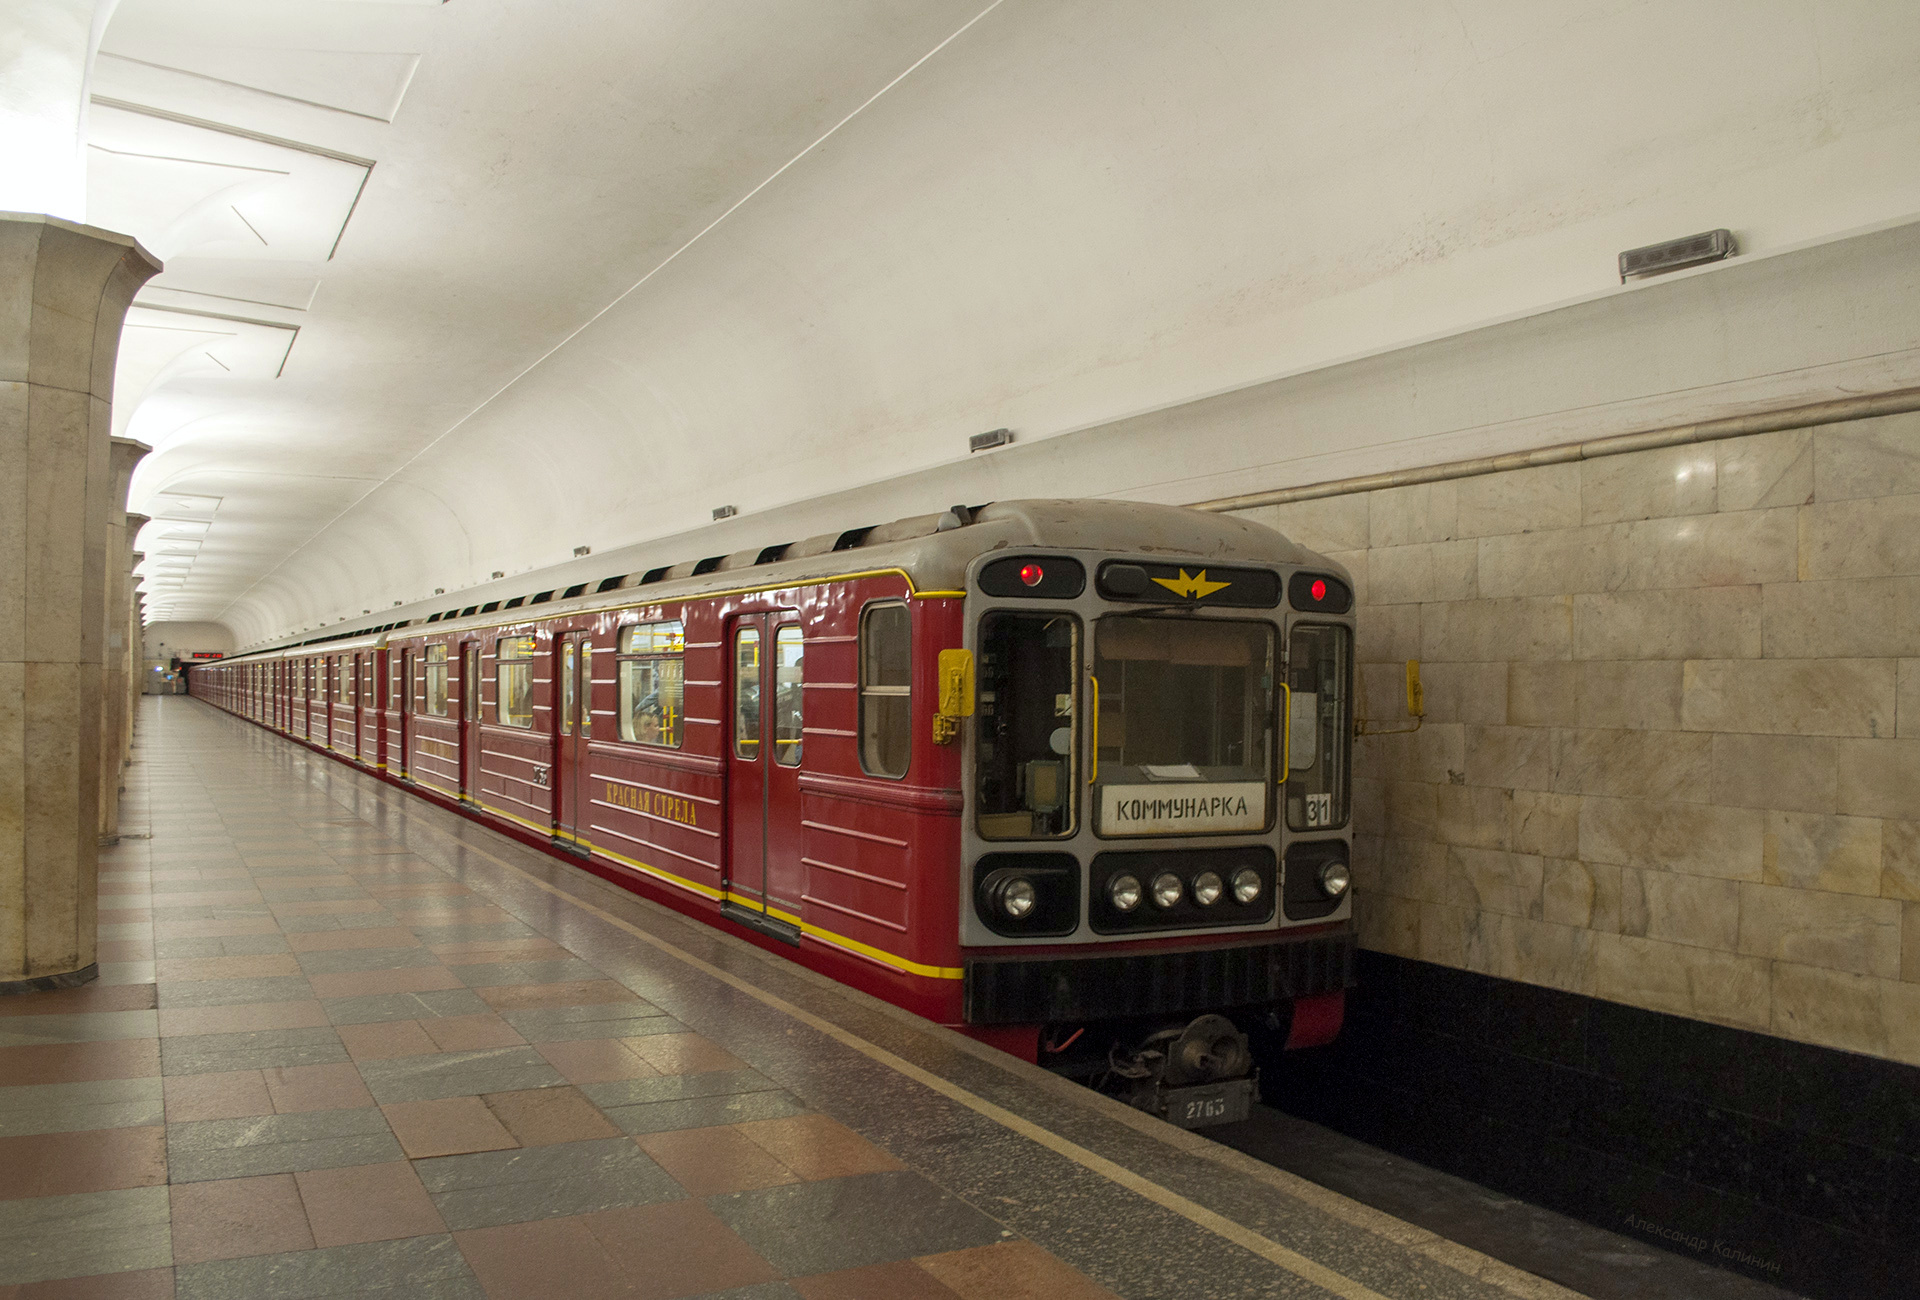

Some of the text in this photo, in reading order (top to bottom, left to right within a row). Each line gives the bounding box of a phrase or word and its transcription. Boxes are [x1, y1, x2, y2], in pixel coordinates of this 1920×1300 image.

[606, 782, 697, 826] КРАСНАЯ СТРЕЛА
[1116, 796, 1248, 821] КОММУНАРКА
[1308, 799, 1328, 822] 31
